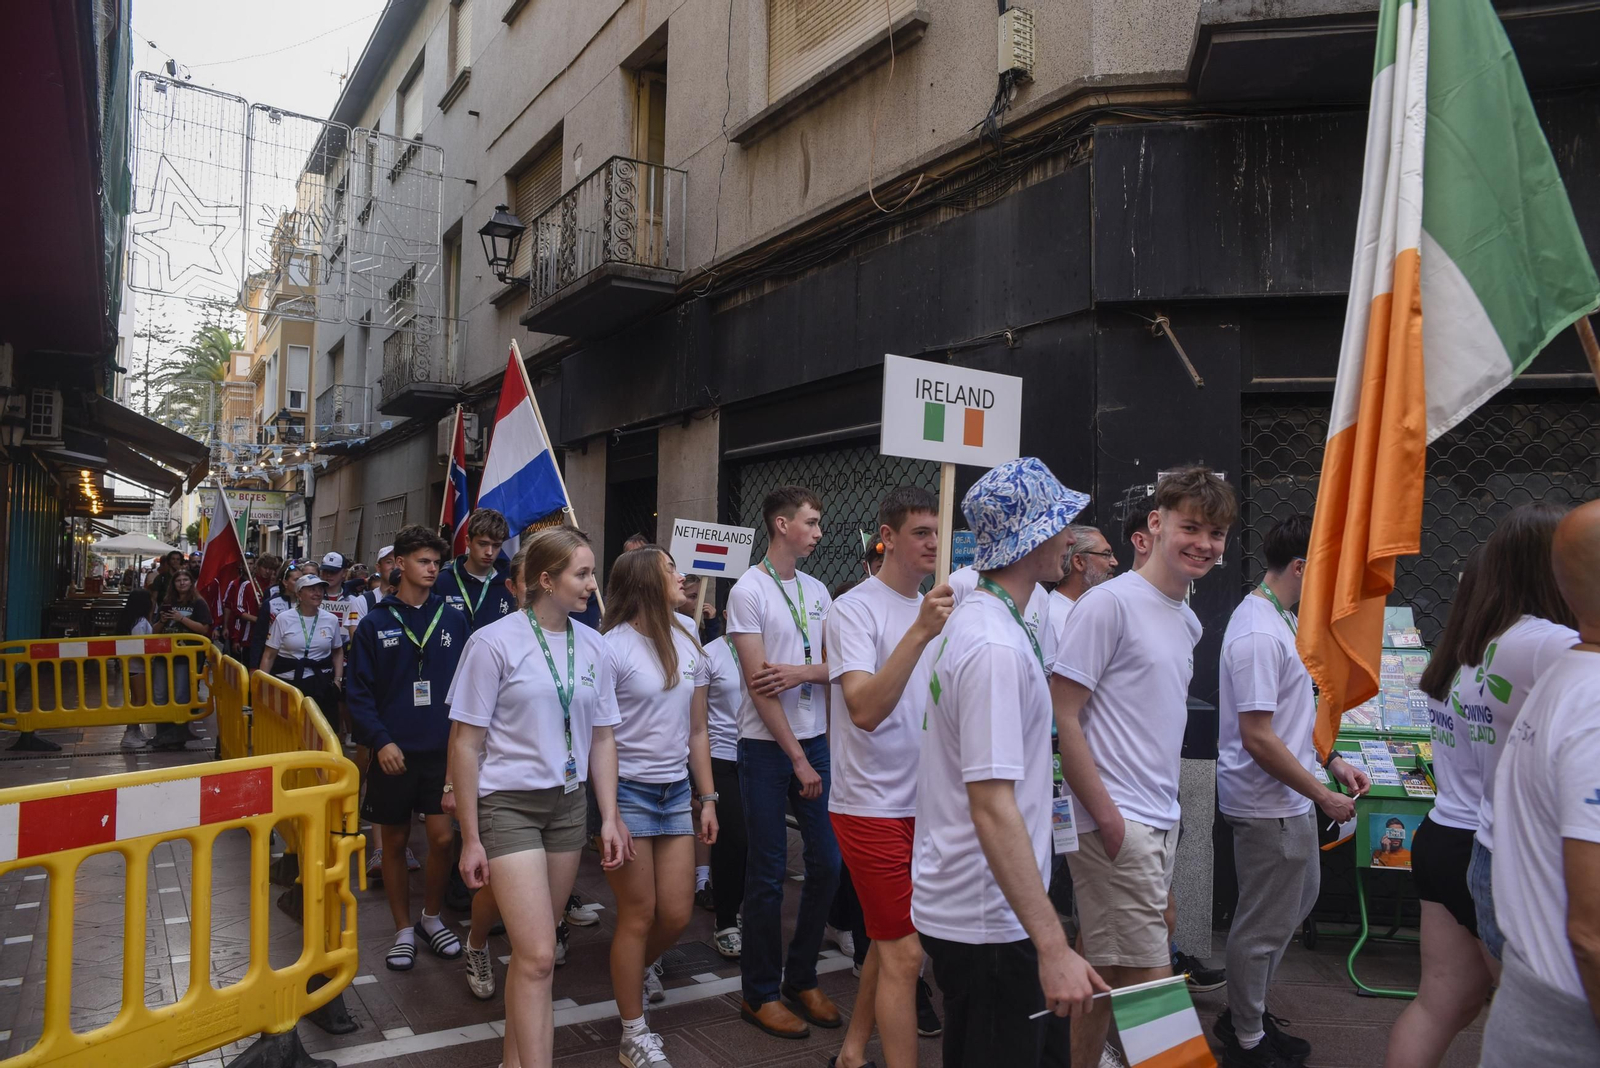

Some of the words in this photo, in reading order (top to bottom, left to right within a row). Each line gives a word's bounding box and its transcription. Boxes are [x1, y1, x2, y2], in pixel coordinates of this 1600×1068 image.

[916, 377, 994, 409] IRELAND
[249, 511, 273, 519] ILLONES
[674, 525, 753, 545] NETHERLANDS
[963, 547, 978, 555] FUM
[319, 602, 350, 612] ORWAY
